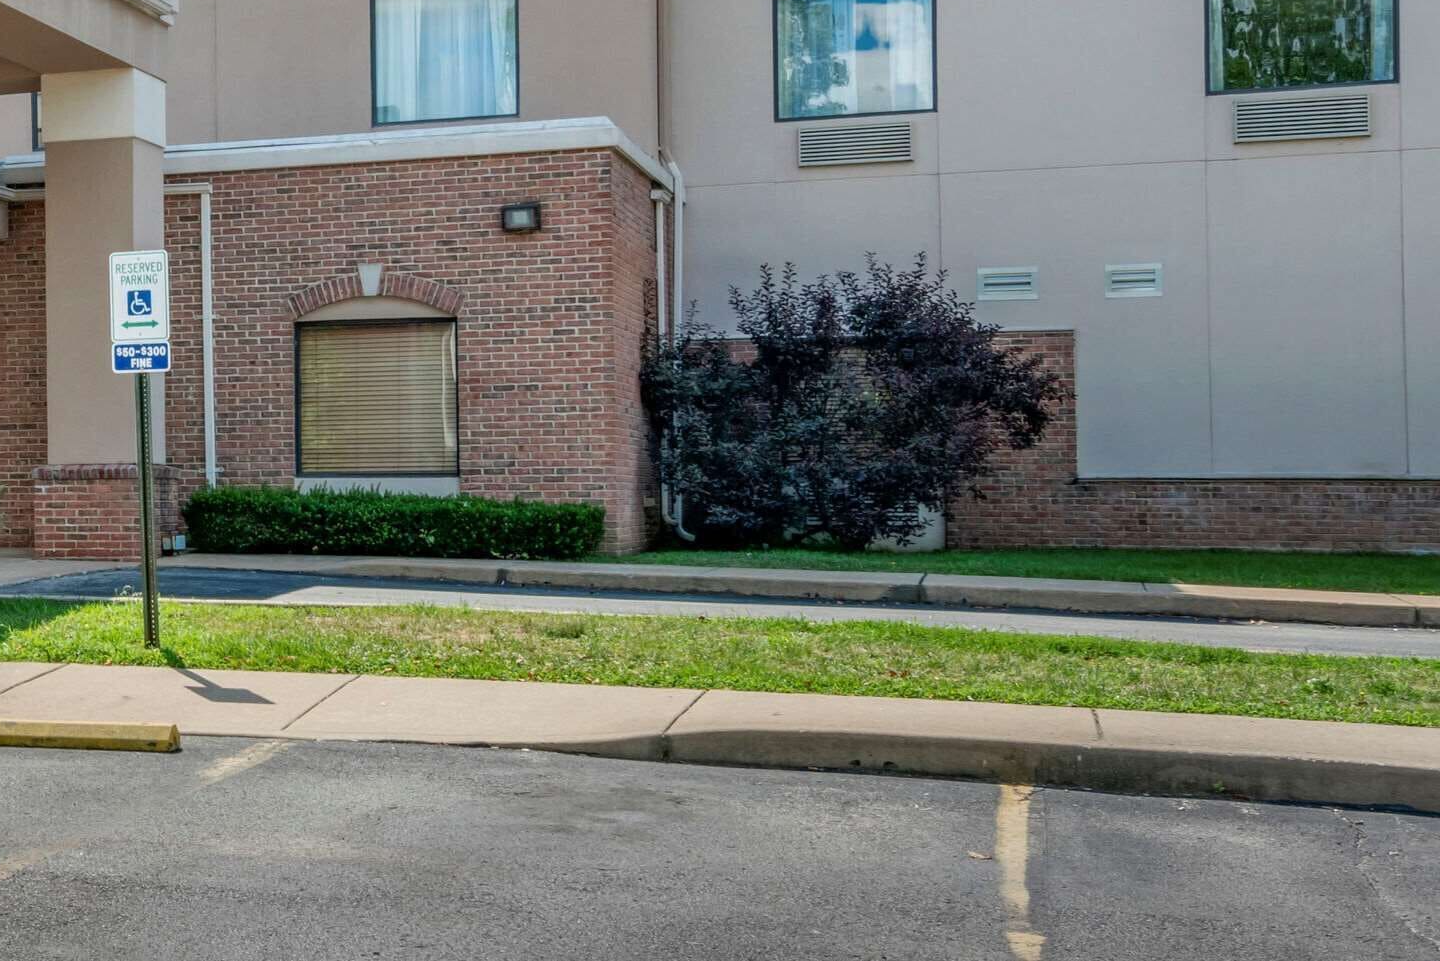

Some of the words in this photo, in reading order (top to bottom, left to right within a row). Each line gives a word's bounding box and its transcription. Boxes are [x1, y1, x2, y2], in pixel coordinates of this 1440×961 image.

[115, 261, 162, 274] RESERVED
[120, 273, 158, 286] PARKING
[116, 346, 166, 357] $50-$300
[130, 357, 152, 369] FINE
